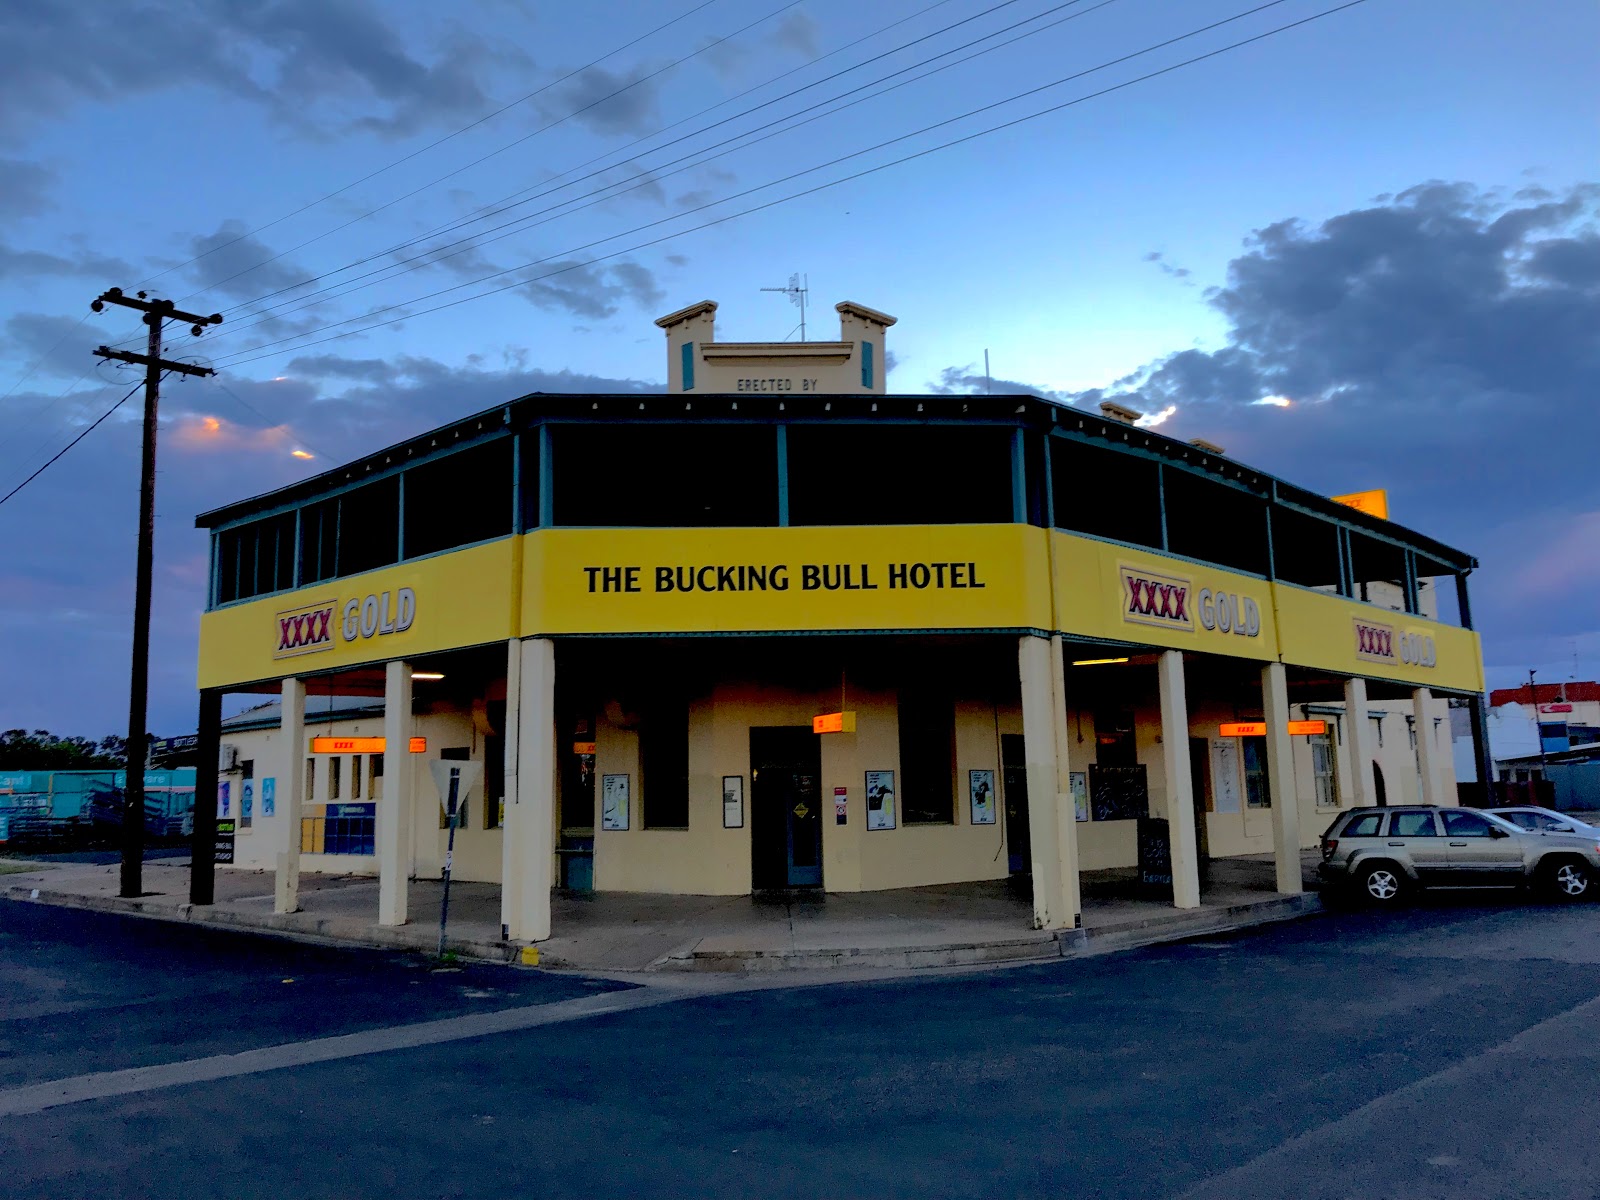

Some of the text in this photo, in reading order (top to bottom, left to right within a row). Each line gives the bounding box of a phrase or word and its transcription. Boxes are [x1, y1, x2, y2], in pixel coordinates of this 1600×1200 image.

[737, 378, 818, 392] ERECTED BY
[583, 562, 986, 593] THE BUCKING BULL HOTEL
[278, 587, 416, 650] XXXX GOLD
[1126, 575, 1260, 638] XXXX GOLD
[1356, 624, 1437, 669] XXXX GOLD
